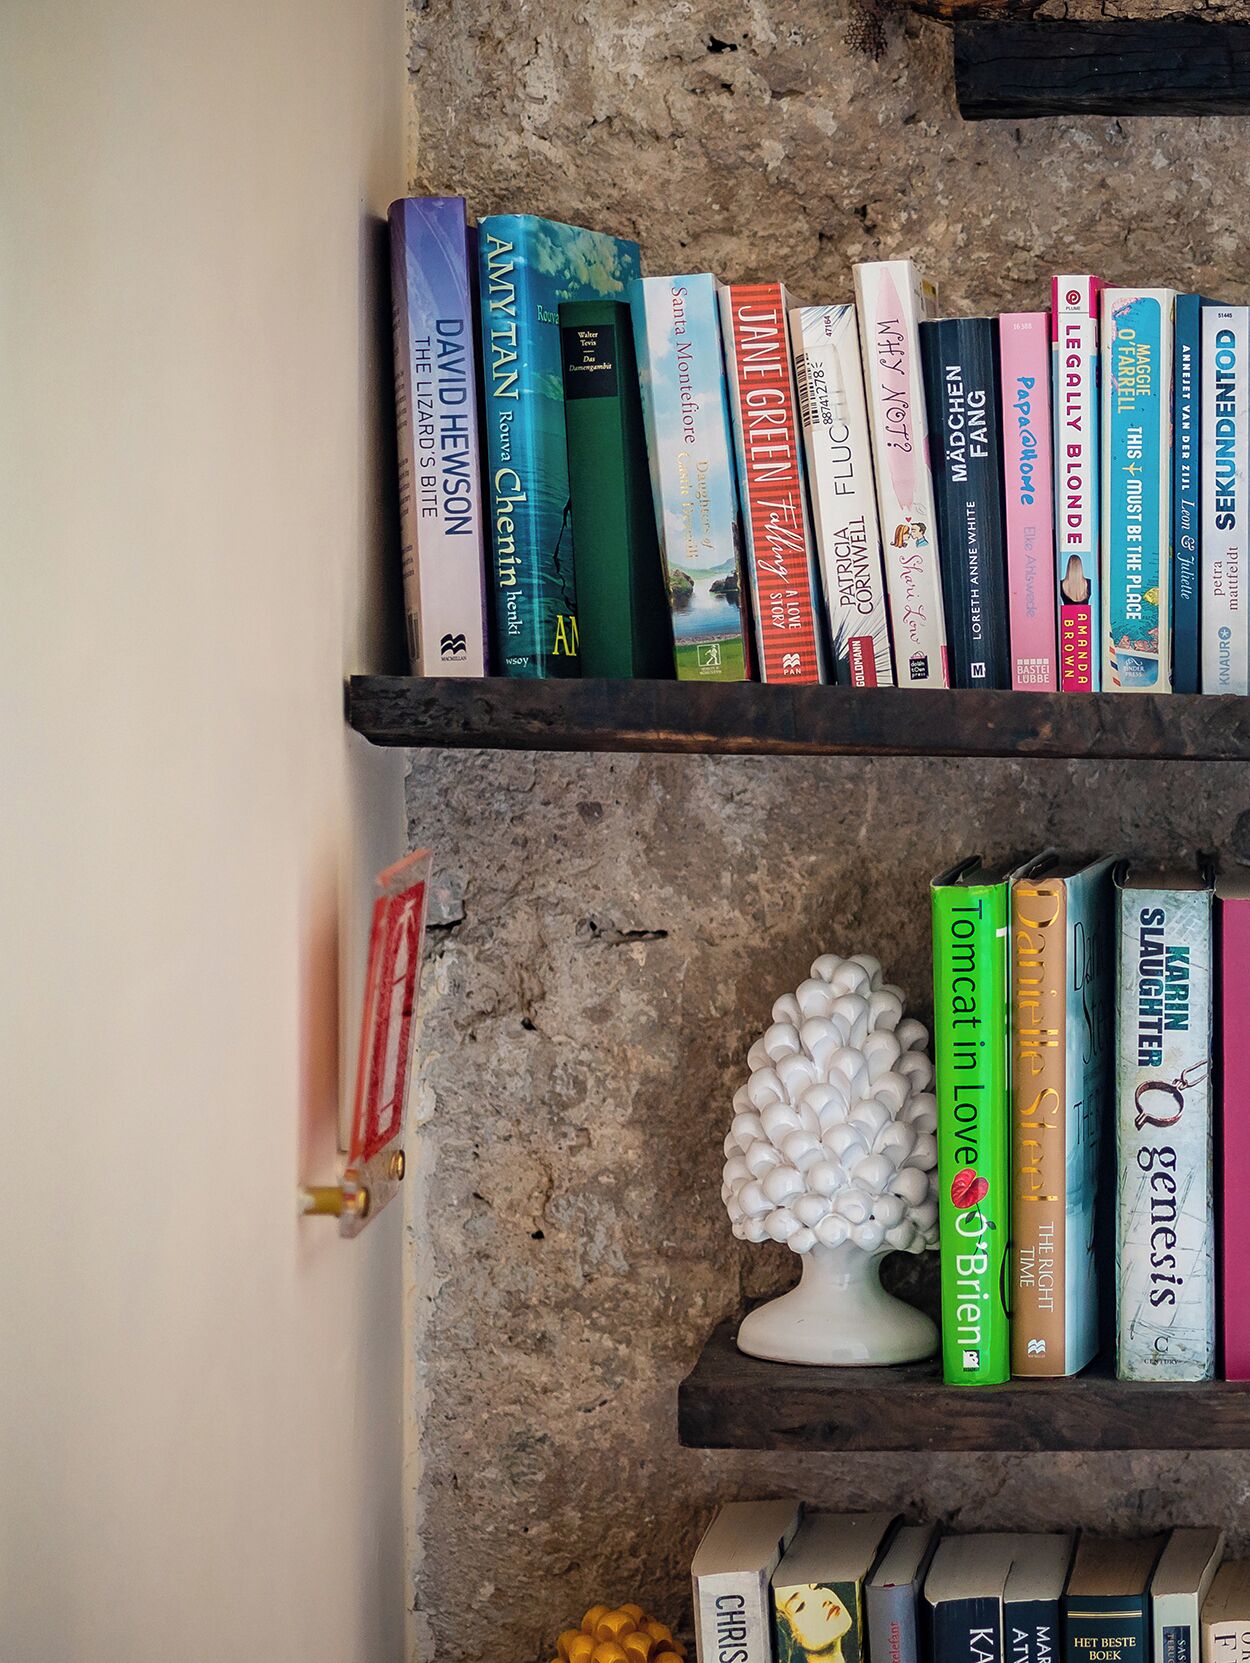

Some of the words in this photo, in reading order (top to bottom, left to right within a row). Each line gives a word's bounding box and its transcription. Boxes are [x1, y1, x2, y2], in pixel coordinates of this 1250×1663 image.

[486, 233, 517, 318] AMY
[577, 331, 599, 339] Walter
[671, 286, 688, 336] Santa
[414, 336, 432, 374] THE
[436, 319, 468, 405] DAVID
[491, 320, 519, 400] TAN
[568, 362, 613, 372] Damengambit
[580, 339, 597, 347] Tevis
[582, 355, 596, 363] Das
[737, 305, 783, 380] JANE
[877, 318, 905, 376] WHY
[676, 342, 700, 444] Montefiore
[1066, 325, 1083, 432] LEGALLY
[1117, 328, 1136, 414] O'FARRELL
[1136, 343, 1151, 396] MAGGIE
[1181, 345, 1191, 400] ANNEJET
[416, 381, 436, 468] LIZARD'S
[499, 410, 515, 462] Rouva
[746, 388, 794, 482] GREEN
[945, 365, 968, 482] MÄDCHEN
[967, 390, 989, 458] FANG
[1126, 426, 1143, 459] THIS
[1181, 405, 1191, 430] VAN
[1215, 329, 1237, 531] SEKUNDENTOD
[1181, 436, 1191, 459] DER
[420, 475, 438, 518] BITE
[440, 414, 474, 536] HEWSON
[1066, 444, 1083, 544] BLONDE
[1181, 465, 1190, 490] ZIJL
[966, 501, 977, 546] WHITE
[1126, 480, 1143, 522] MUST
[1181, 499, 1196, 530] Leon
[494, 467, 528, 588] Chenin
[757, 491, 804, 584] Falling
[1023, 526, 1036, 550] Elke
[1126, 525, 1142, 542] BE
[1181, 535, 1195, 551] &
[834, 526, 857, 608] PATRICIA
[849, 515, 874, 615] CORNWELL
[898, 554, 924, 600] Shari
[968, 547, 980, 585] ANNE
[1126, 546, 1142, 571] THE
[1177, 552, 1195, 600] Juliette
[1213, 560, 1226, 597] petra
[1226, 546, 1239, 611] mattfeldt
[506, 590, 523, 635] henki
[769, 592, 786, 629] STORY
[785, 590, 798, 598] A
[787, 602, 802, 629] LOVE
[970, 589, 983, 640] LORETH
[1126, 576, 1142, 620] PLACE
[851, 640, 865, 687] GOLDMANN
[1016, 665, 1050, 675] BASTEI
[1064, 619, 1076, 678] BROWN
[1077, 613, 1089, 684] AMANDA
[1218, 641, 1233, 686] KNAUR
[951, 899, 983, 1029] Tomcat
[1016, 889, 1061, 1078] Danielle
[1138, 907, 1166, 1068] SLAUGHTER
[1163, 946, 1191, 1031] KARIN
[952, 1041, 986, 1070] in
[953, 1084, 985, 1165] Love
[1020, 1087, 1060, 1202] Steel
[1038, 1221, 1055, 1257] THE
[1136, 1145, 1184, 1308] genesis
[1019, 1246, 1035, 1288] TIME
[1038, 1258, 1055, 1313] RIGHT
[1074, 1637, 1099, 1648] HET
[1101, 1636, 1137, 1648] BESTE
[1089, 1650, 1122, 1661] BOEK
